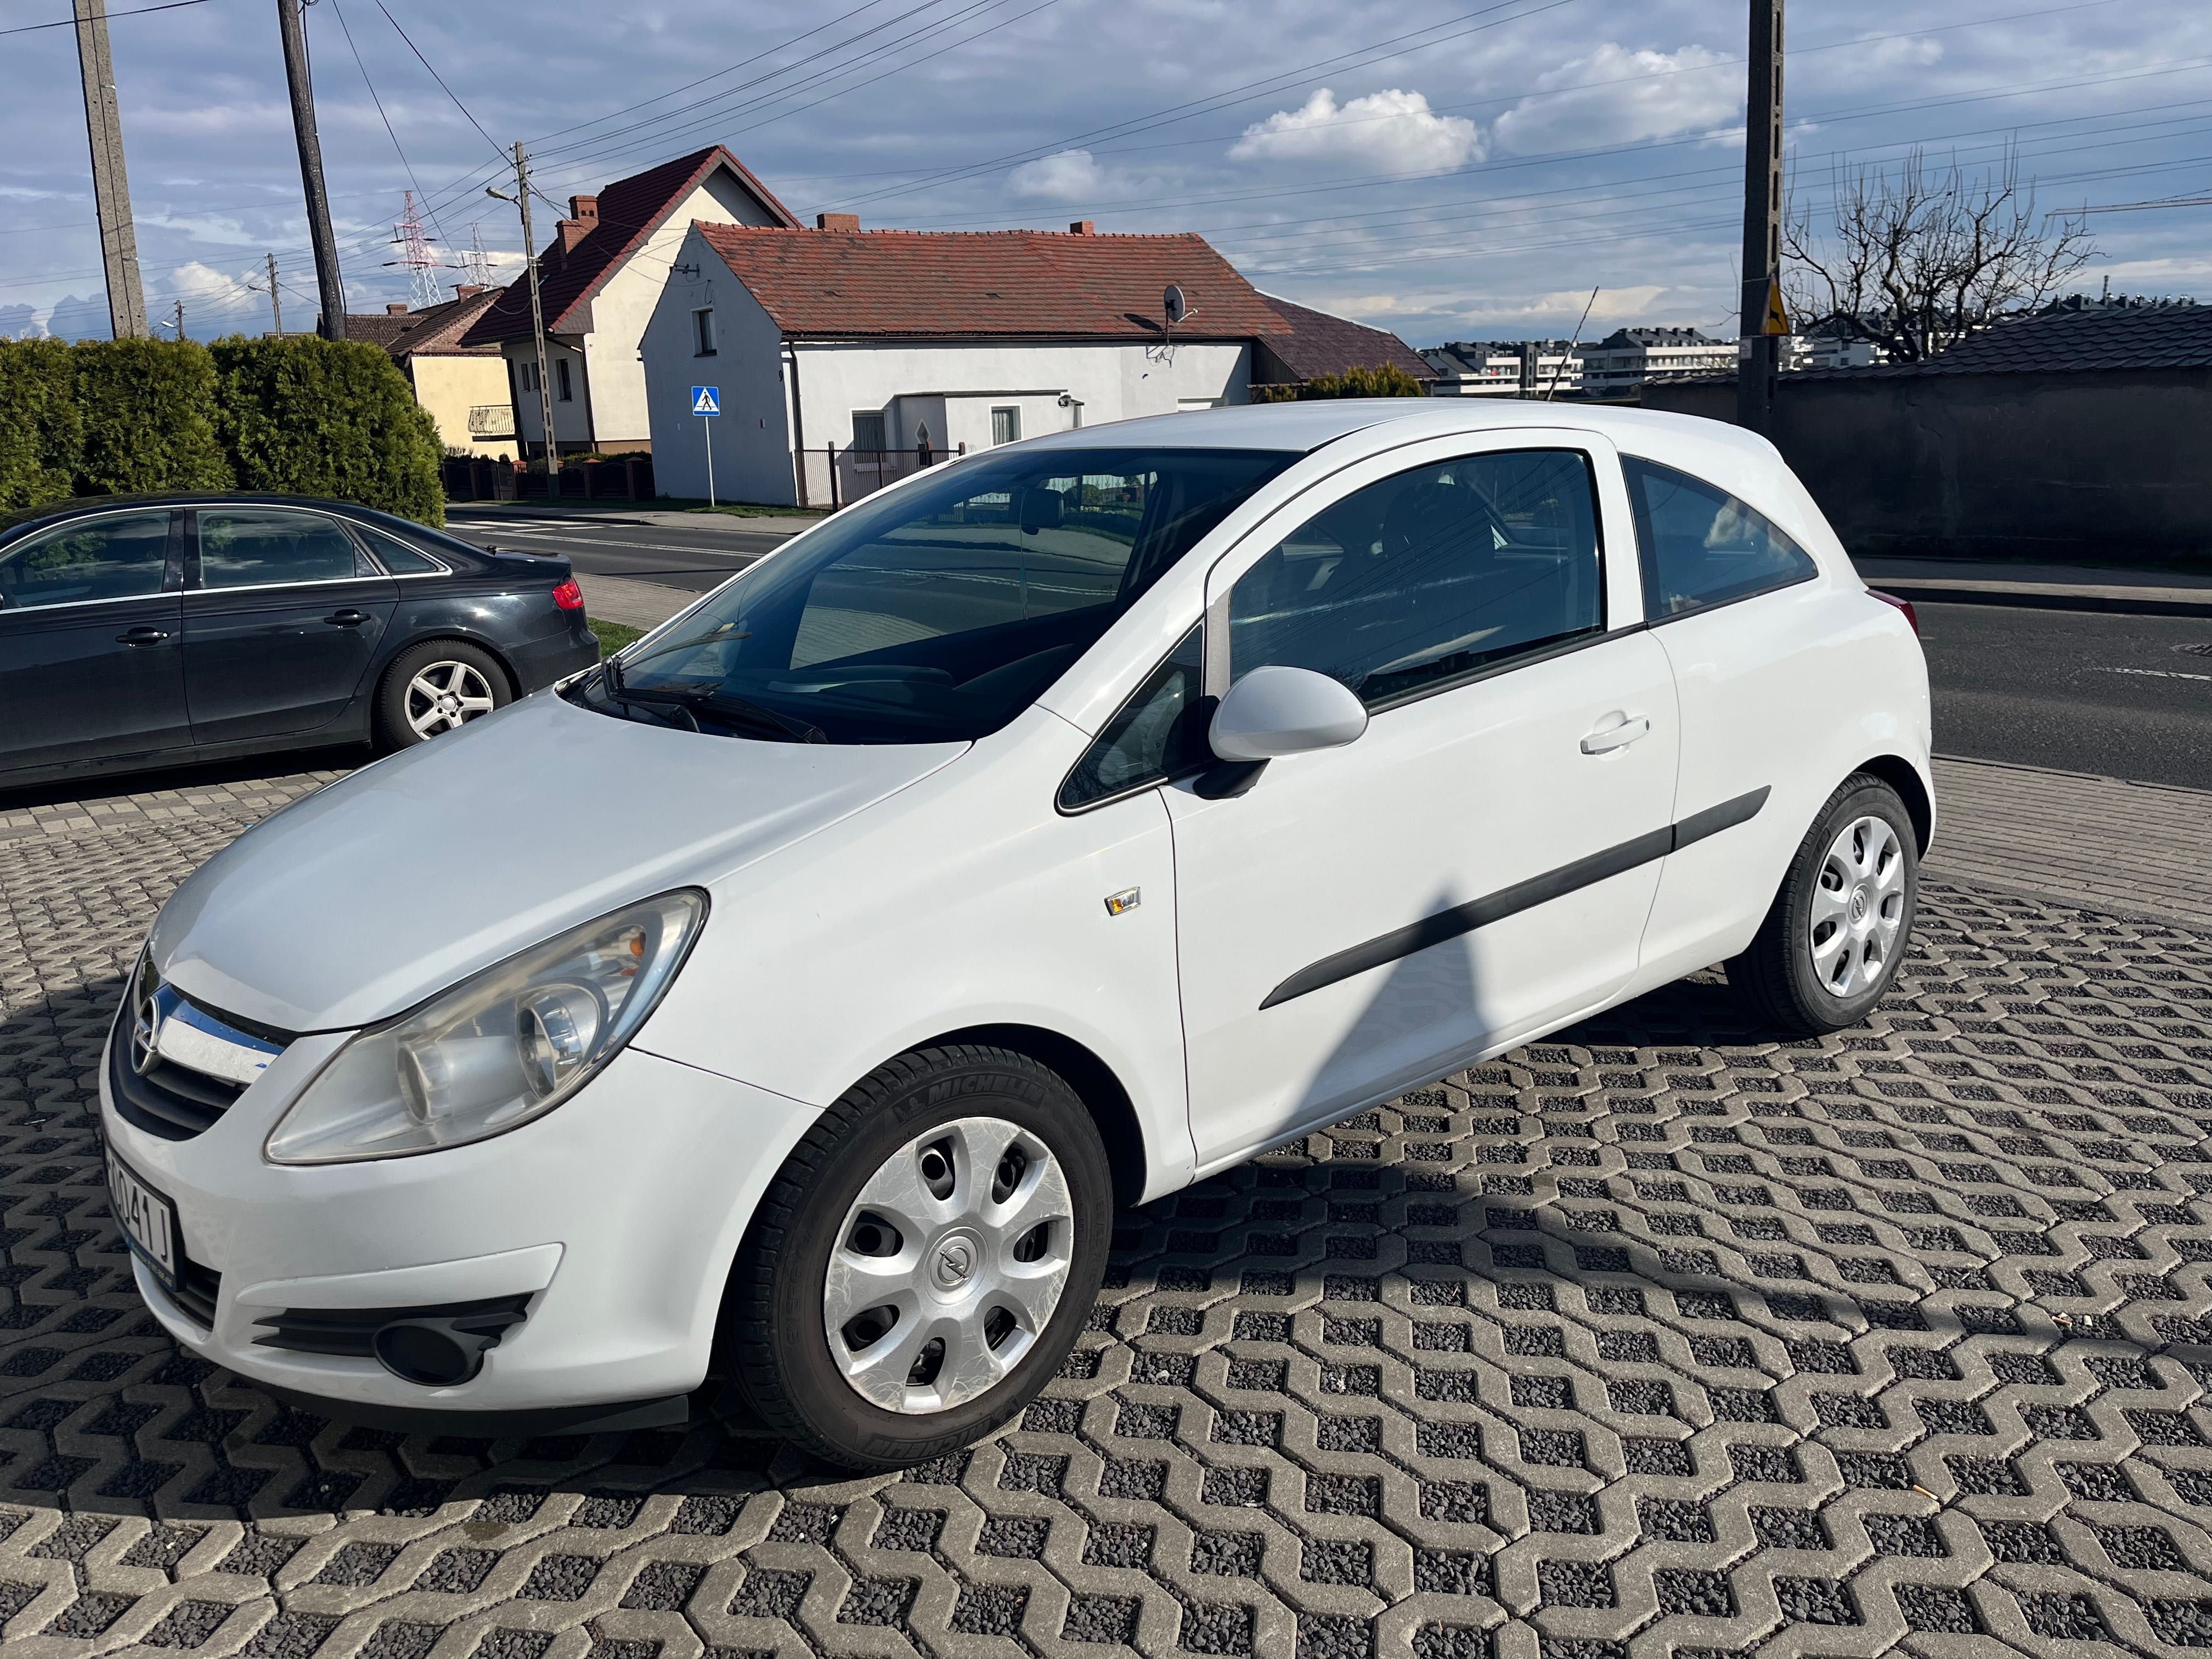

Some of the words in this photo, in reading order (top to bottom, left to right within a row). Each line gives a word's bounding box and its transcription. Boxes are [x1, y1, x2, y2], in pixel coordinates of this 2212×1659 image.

[778, 370, 783, 382] 9
[928, 1074, 1046, 1104] MICHELIN
[786, 1249, 803, 1345] ENERGY
[864, 1419, 991, 1458] MICHELIN
